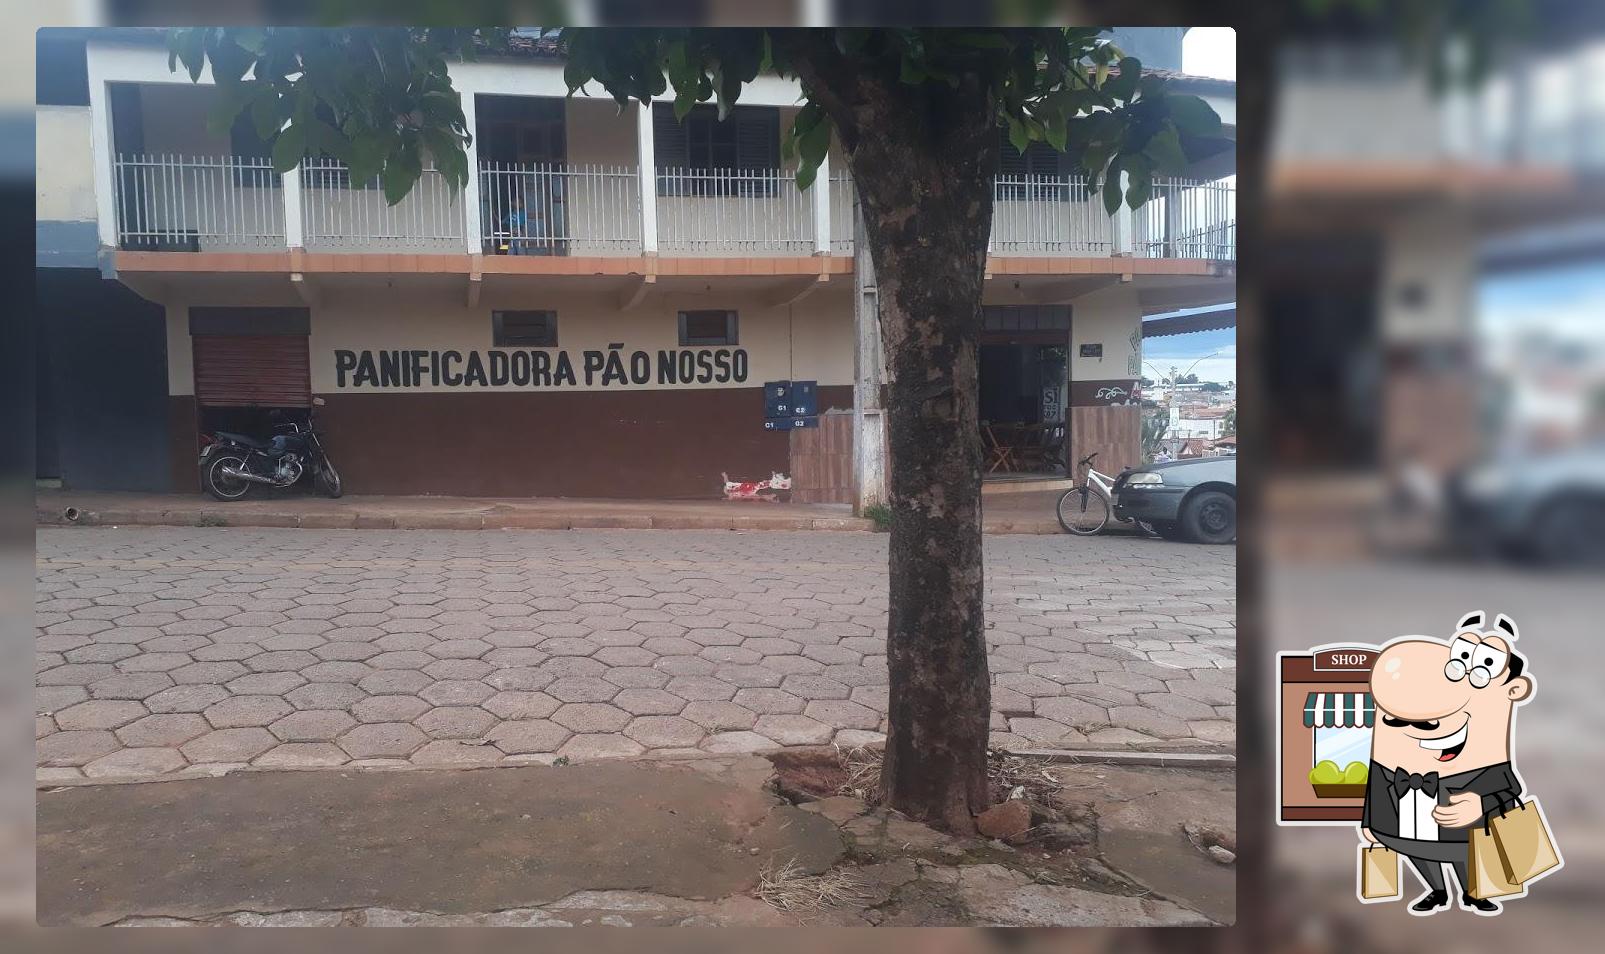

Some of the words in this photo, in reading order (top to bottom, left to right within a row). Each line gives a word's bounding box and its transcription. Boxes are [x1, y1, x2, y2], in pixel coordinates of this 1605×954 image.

[334, 349, 577, 388] PANIFICADORA
[583, 343, 651, 386] PÃO
[657, 348, 749, 385] NOSSO
